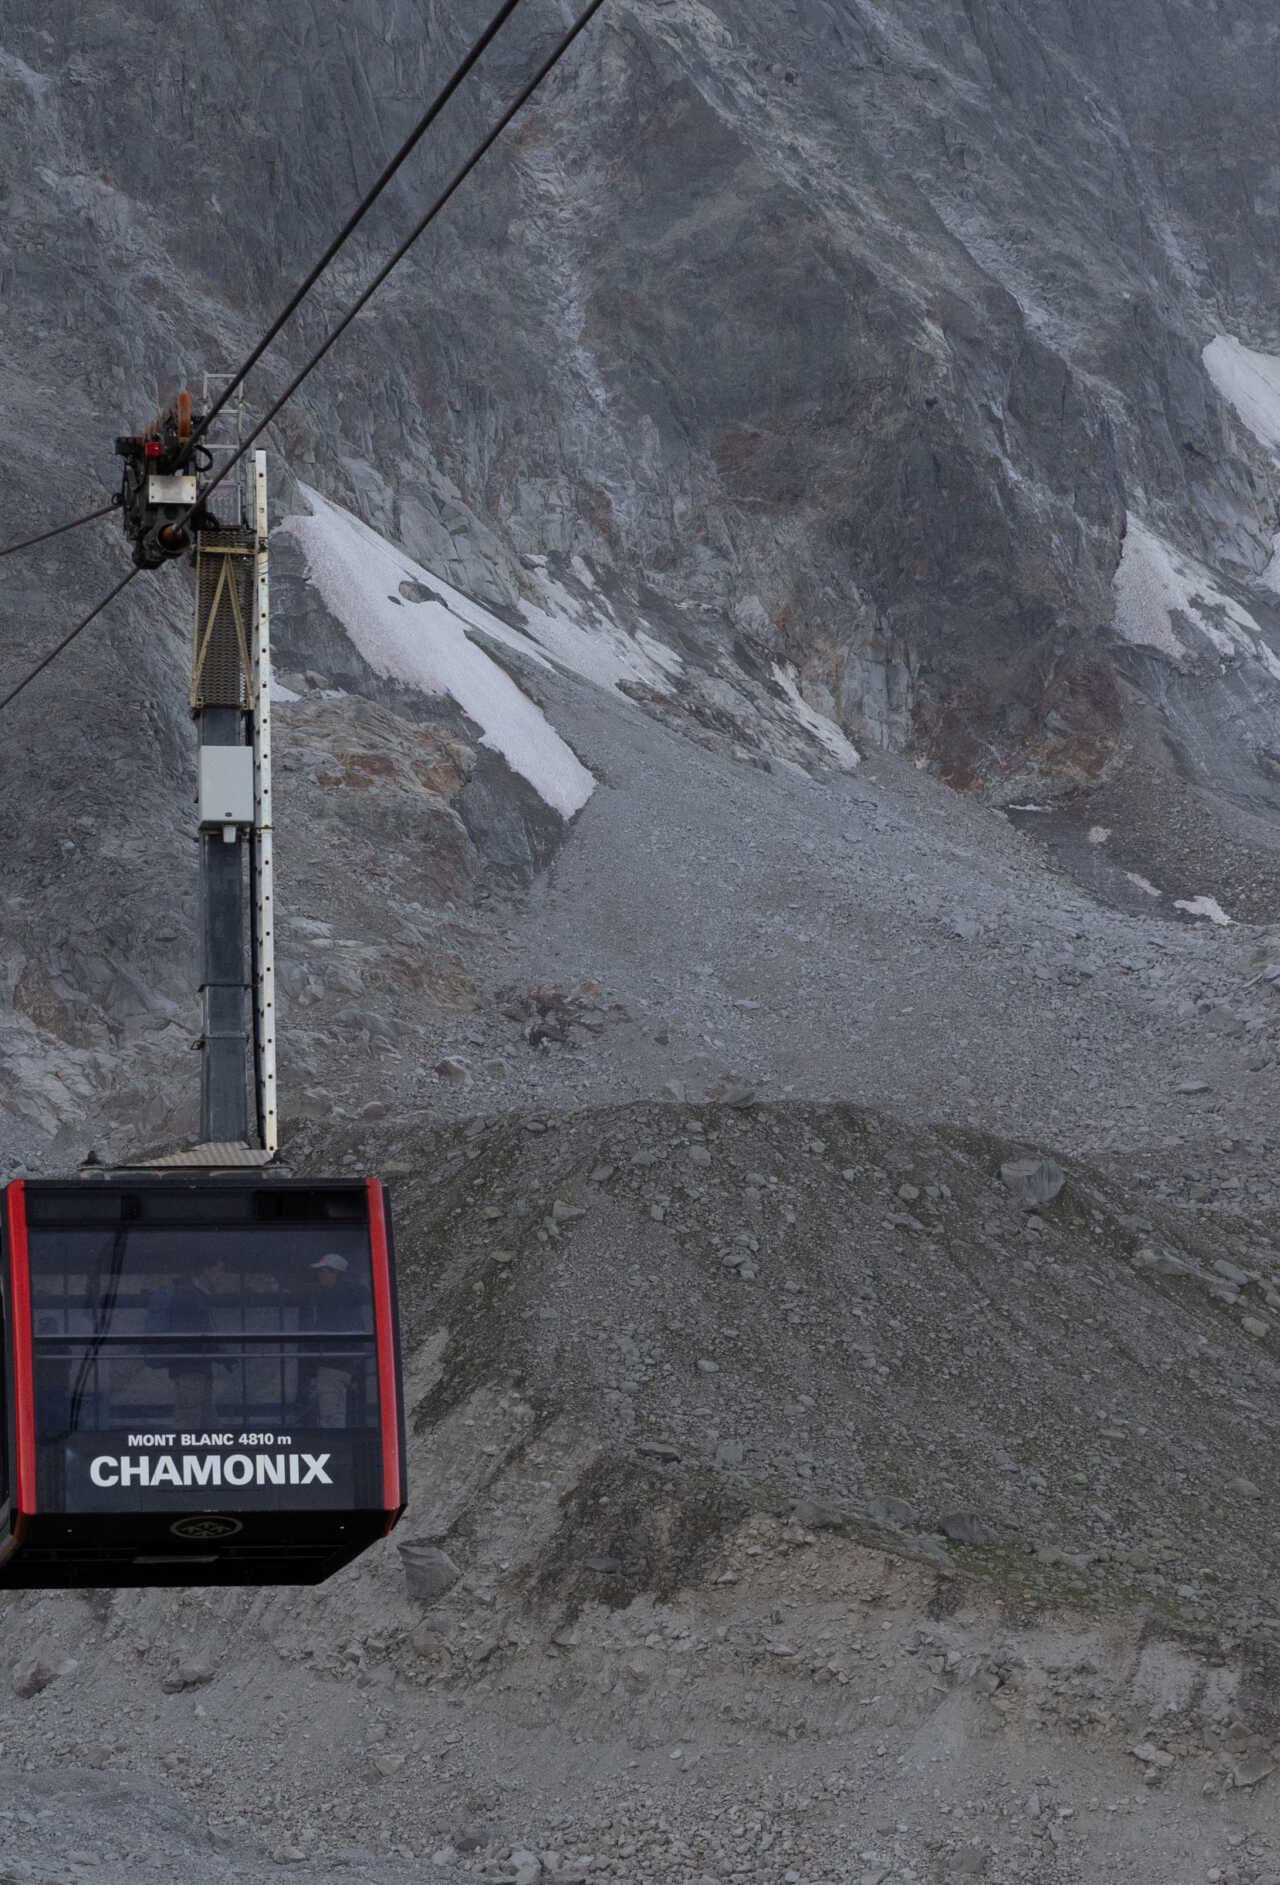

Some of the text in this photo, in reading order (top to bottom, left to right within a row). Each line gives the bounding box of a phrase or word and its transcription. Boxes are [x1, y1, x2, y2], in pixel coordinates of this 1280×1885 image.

[128, 1433, 292, 1446] MONT BLANC 4810 m
[90, 1454, 333, 1487] CHAMONIX
